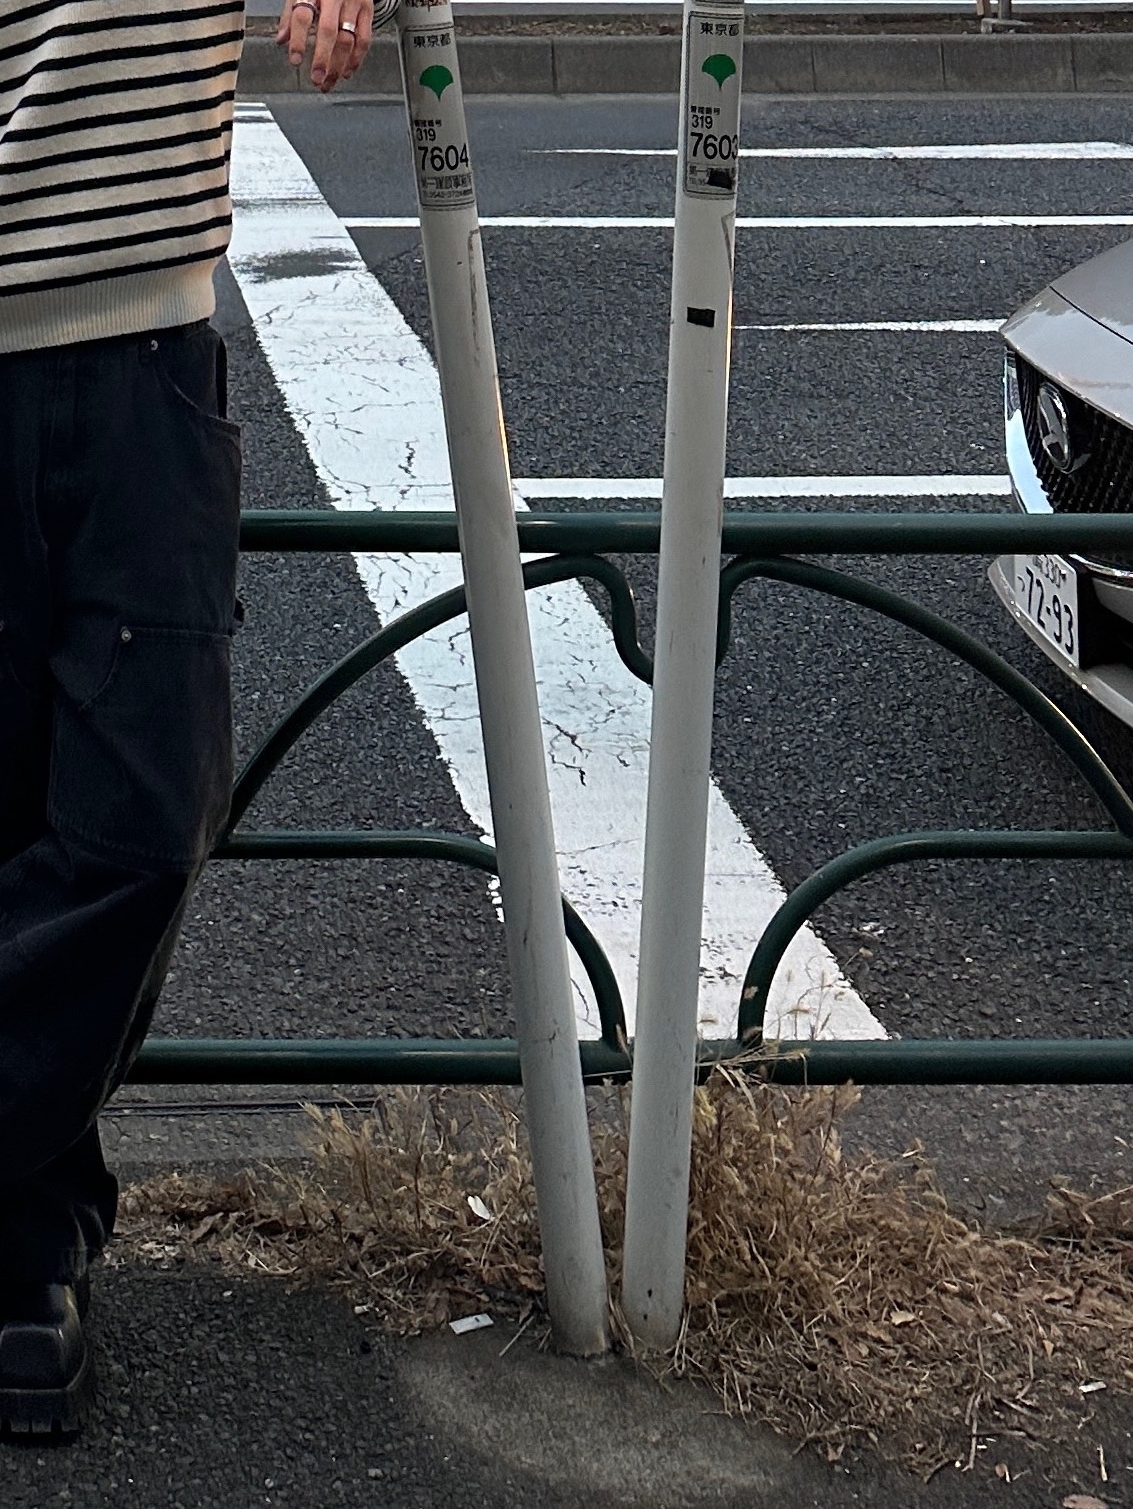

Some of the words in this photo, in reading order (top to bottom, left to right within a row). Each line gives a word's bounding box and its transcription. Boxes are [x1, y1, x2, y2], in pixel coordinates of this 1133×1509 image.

[700, 21, 740, 37] 東京都
[413, 32, 452, 49] 東京都
[691, 114, 713, 130] 319
[415, 128, 437, 142] 319
[418, 143, 469, 172] 7604
[1025, 565, 1074, 655] 72-93
